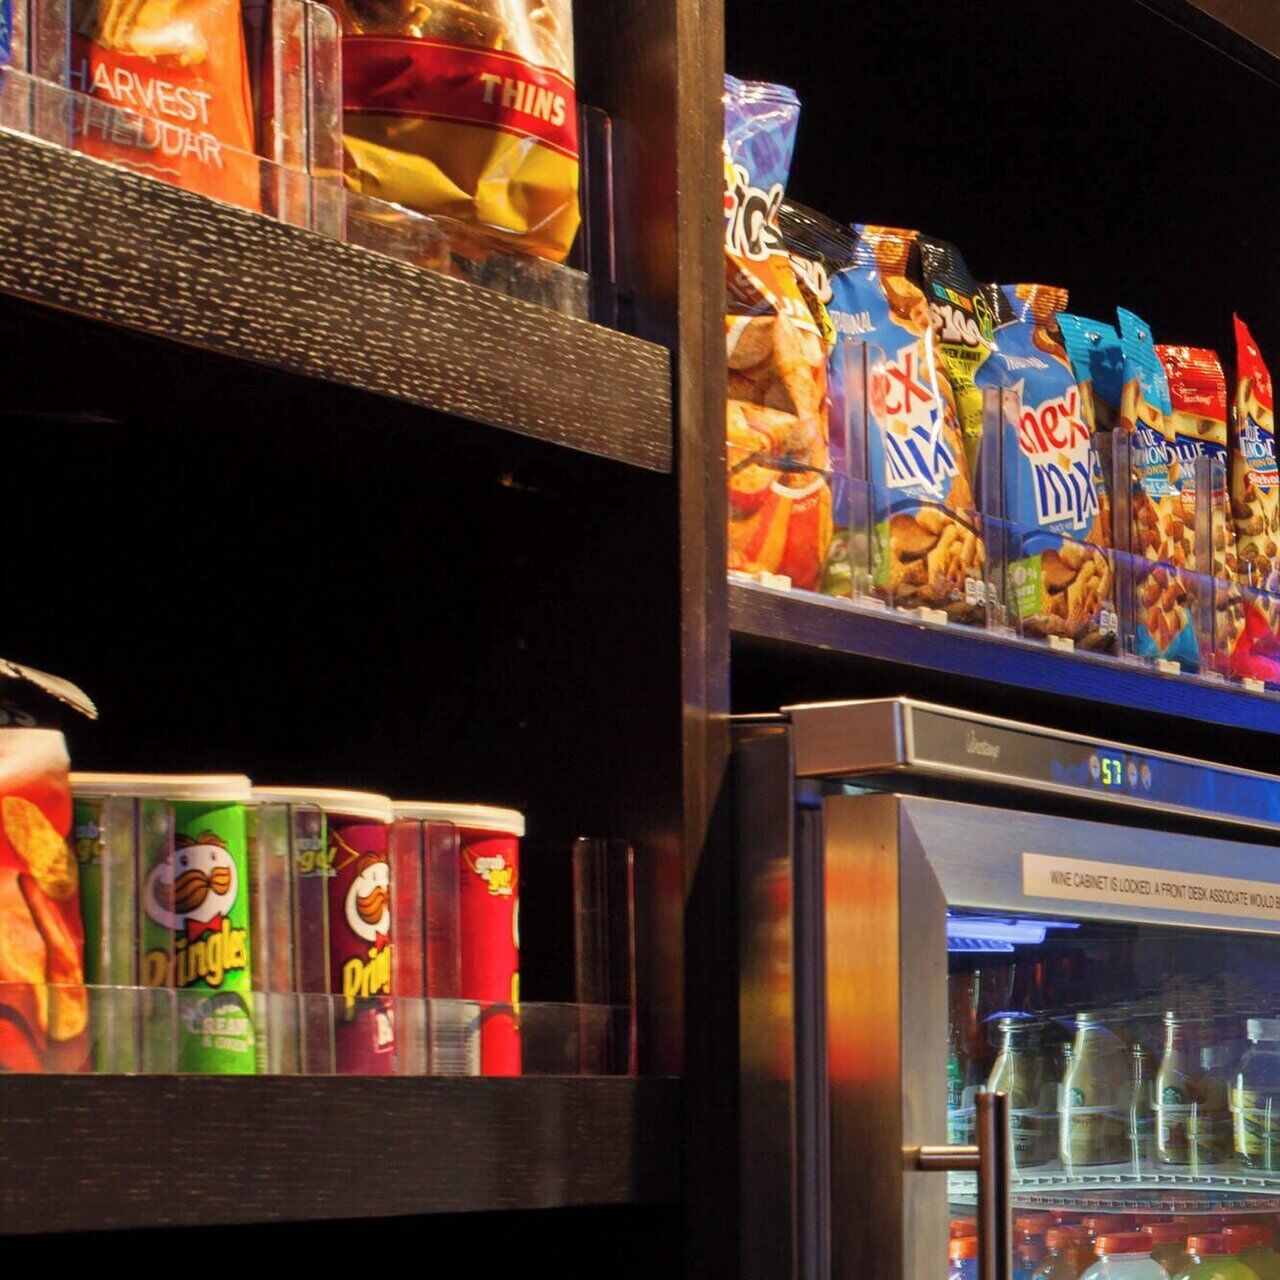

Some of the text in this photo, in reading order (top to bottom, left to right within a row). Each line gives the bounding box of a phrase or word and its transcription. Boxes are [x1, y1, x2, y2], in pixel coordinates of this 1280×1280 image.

[67, 57, 212, 125] HARVEST
[479, 72, 566, 127] THINS
[1017, 391, 1090, 454] hex
[1033, 460, 1100, 524] mix
[1050, 870, 1072, 887] WINE
[1073, 872, 1109, 891] CABINET
[1110, 877, 1118, 892] IS
[1154, 882, 1160, 896] A
[1161, 883, 1187, 899] FRONT
[1188, 886, 1208, 901] DESK
[1209, 888, 1248, 906] ASSOCIATE
[1249, 894, 1274, 909] WOULD
[145, 919, 247, 989] Pringles
